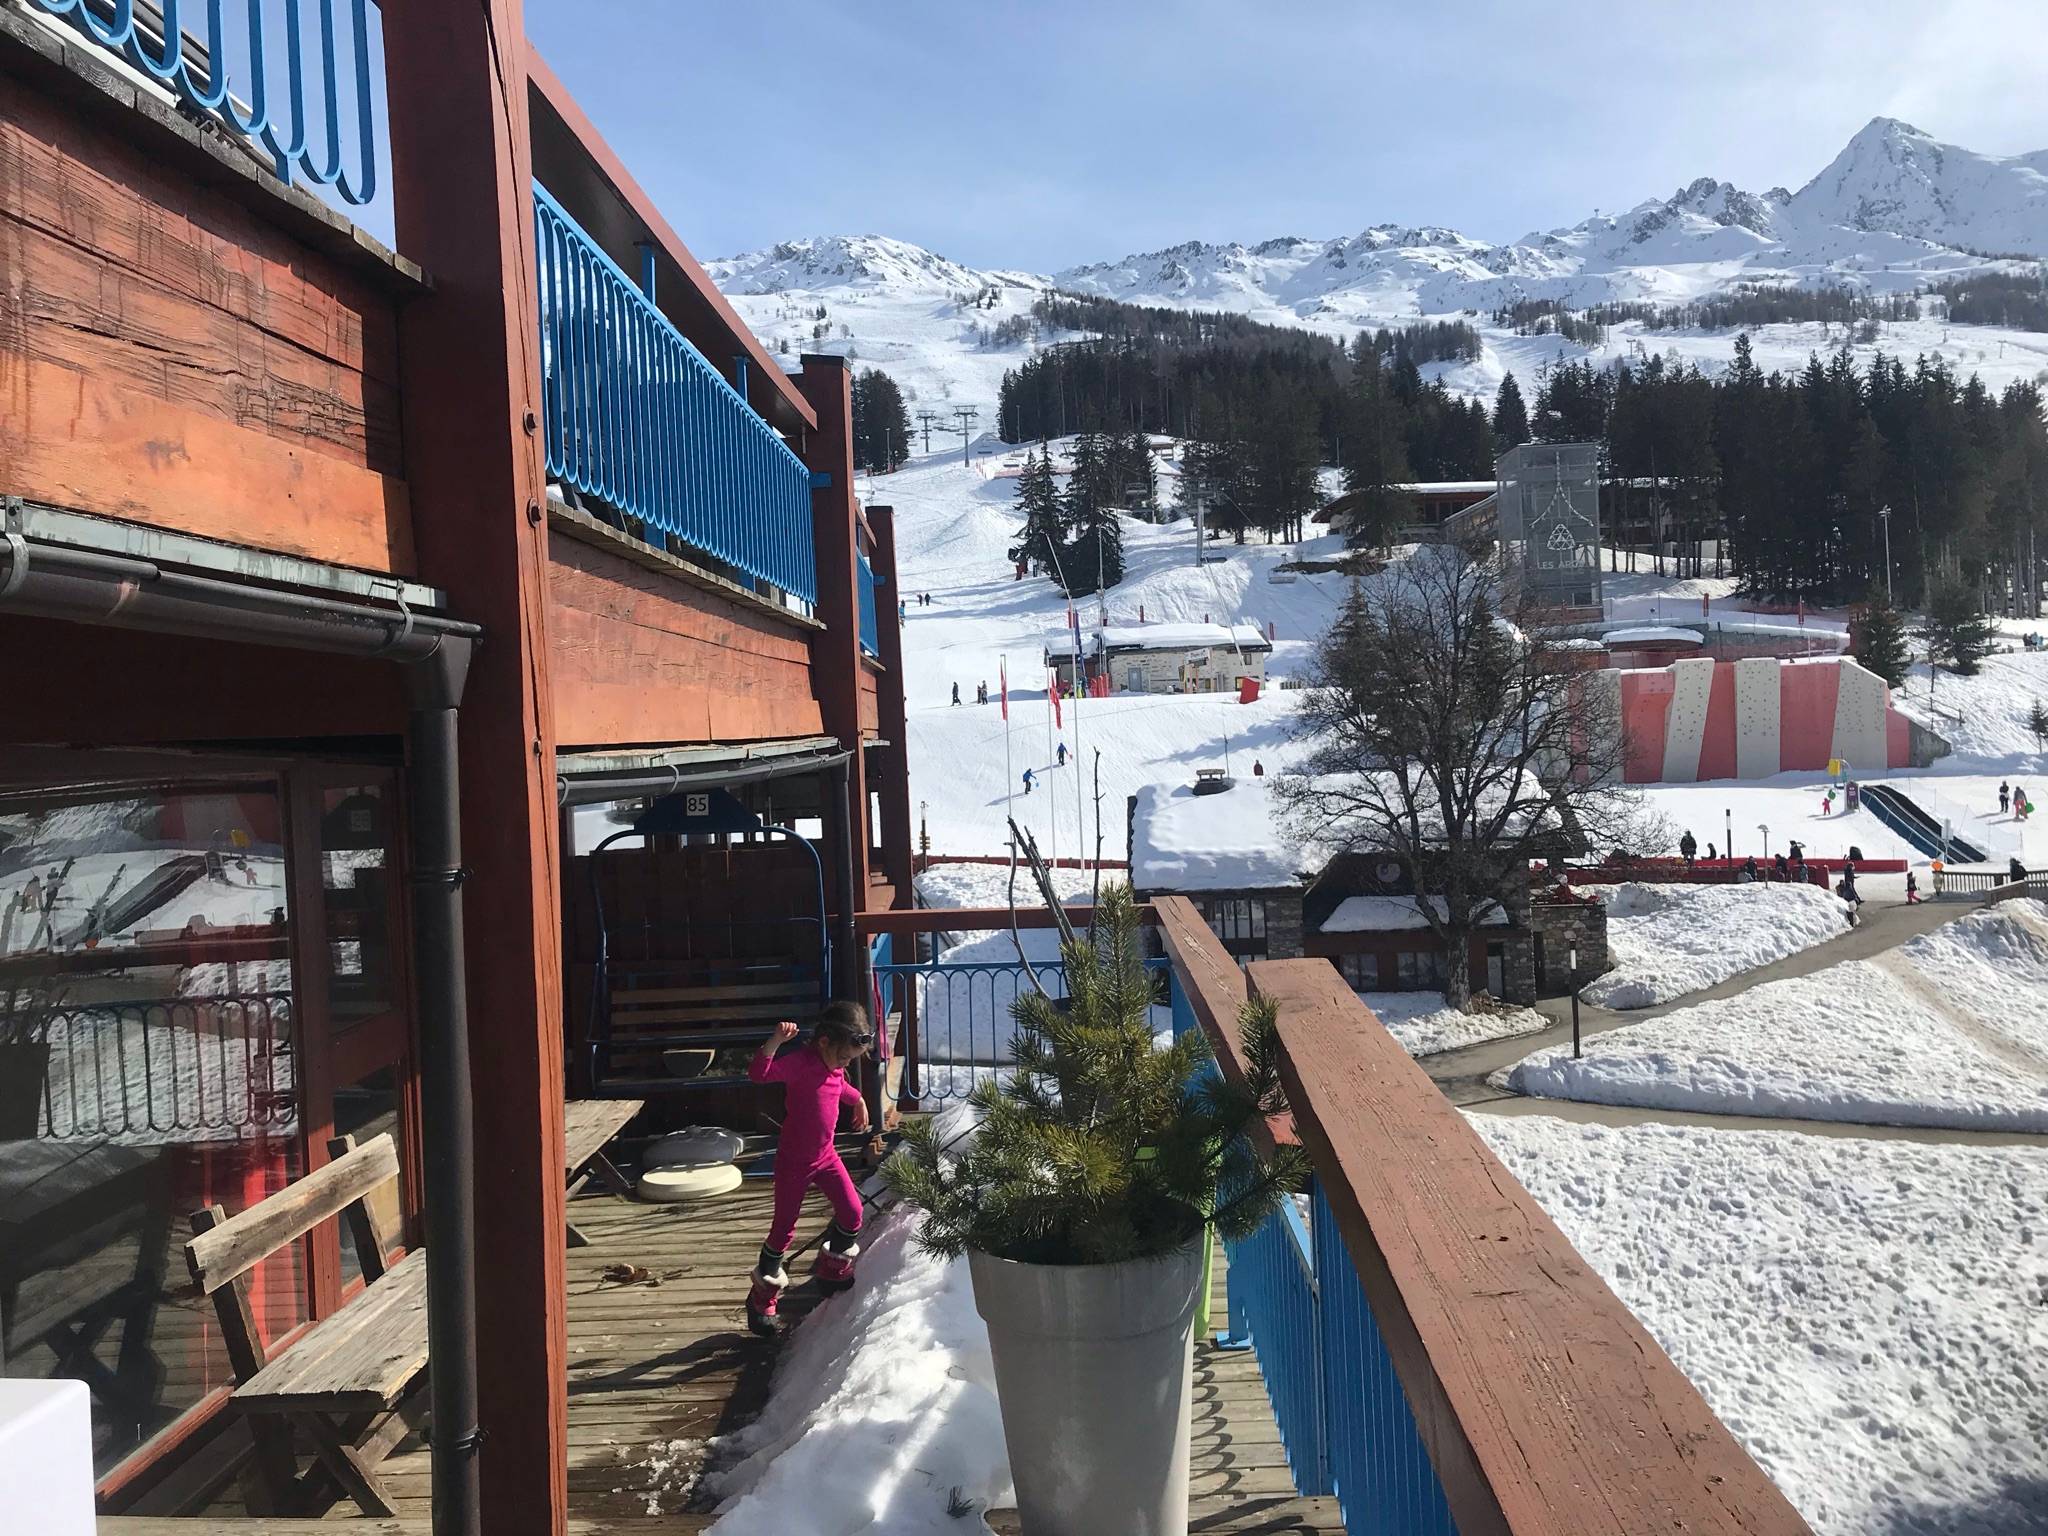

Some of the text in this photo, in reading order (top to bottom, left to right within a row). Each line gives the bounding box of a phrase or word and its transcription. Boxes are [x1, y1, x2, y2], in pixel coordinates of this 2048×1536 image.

[1537, 560, 1585, 570] LES ARC
[687, 797, 707, 812] 85
